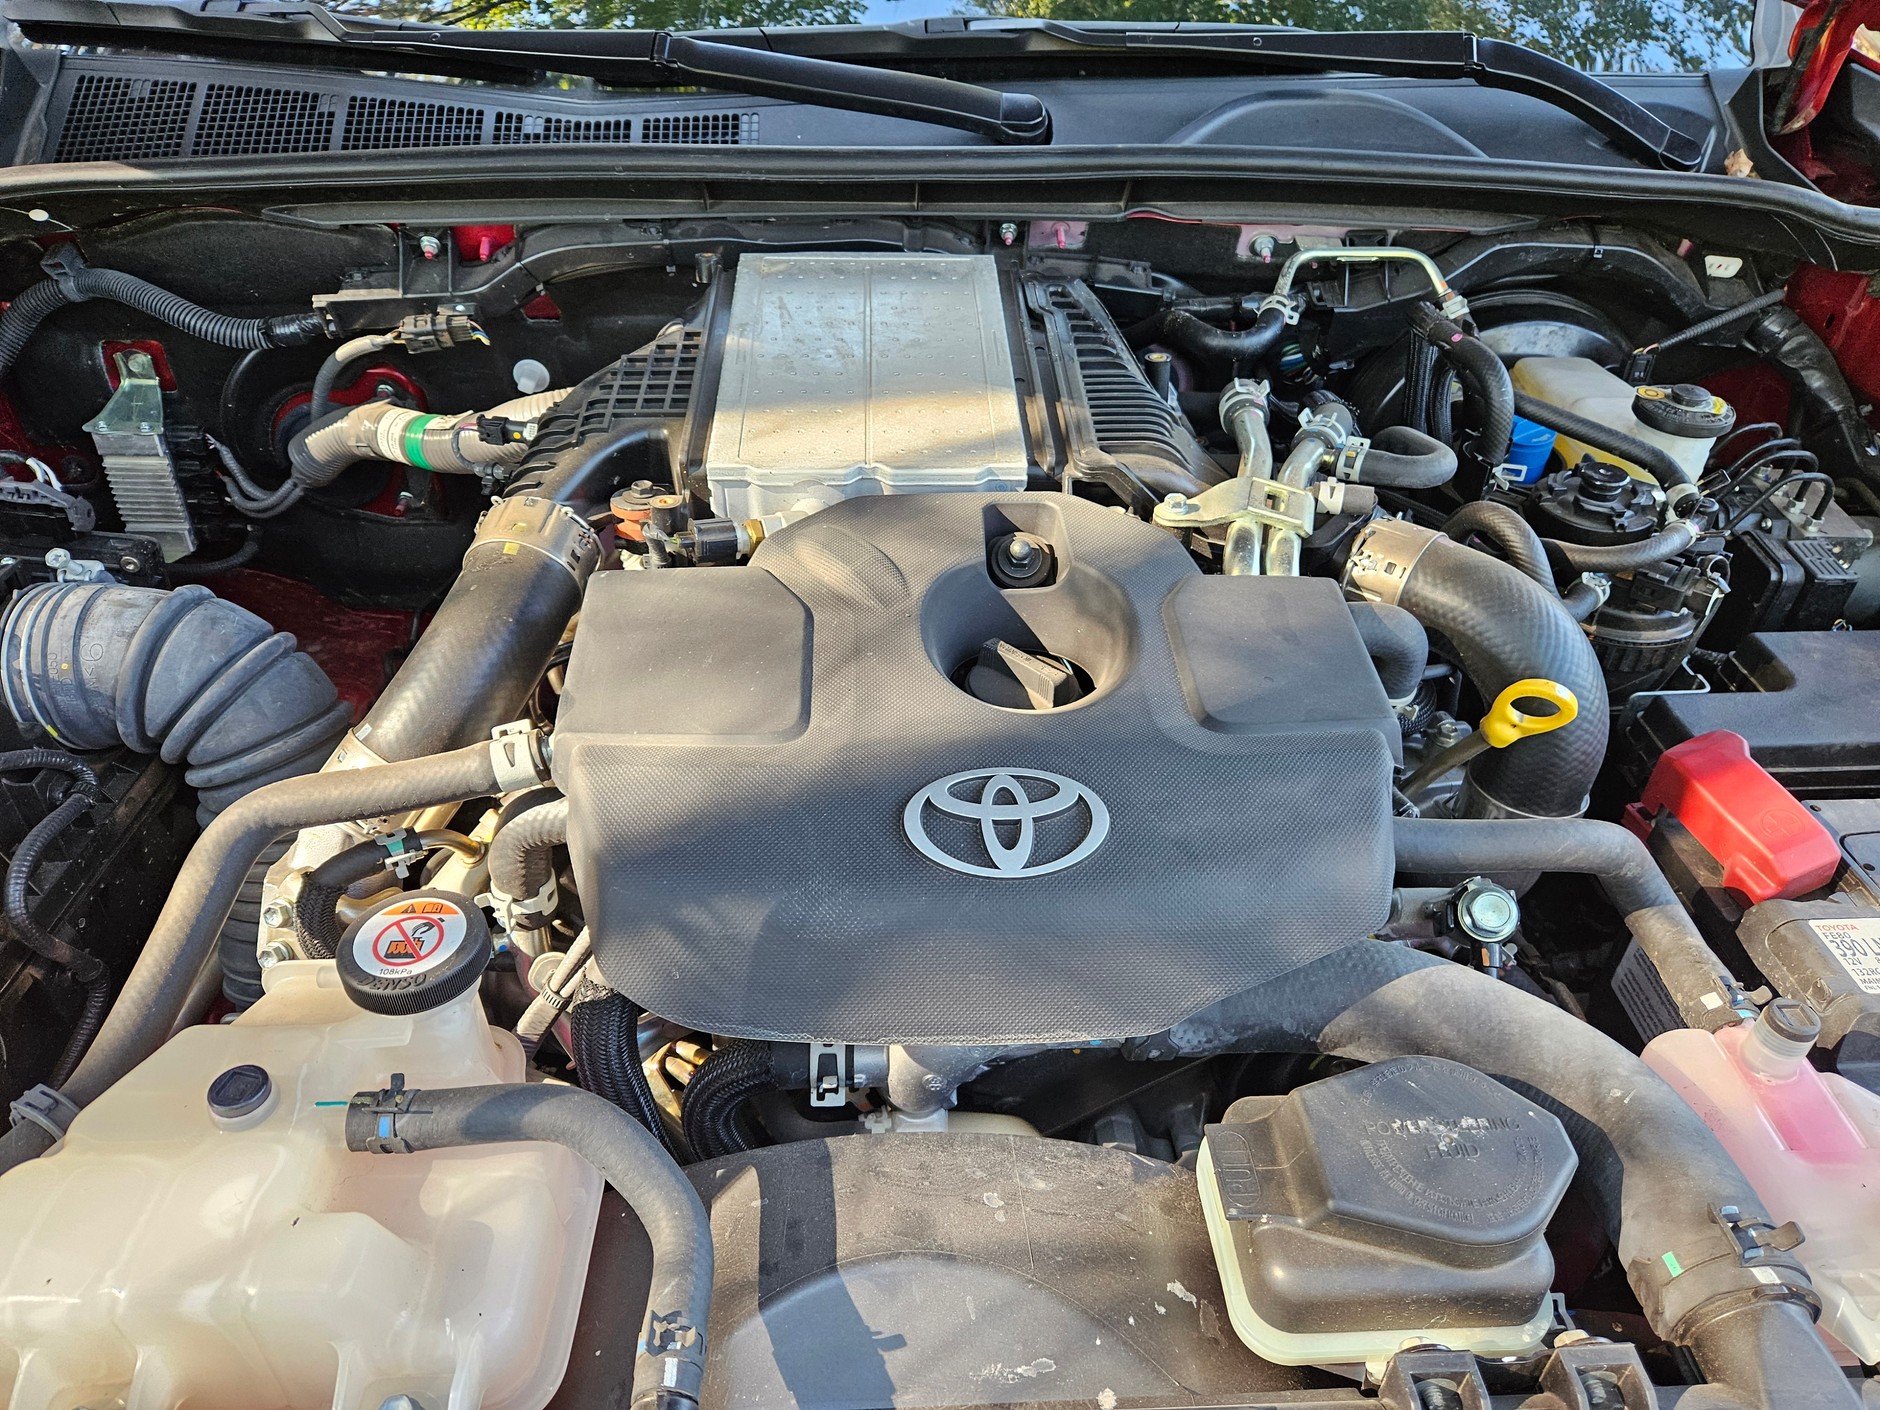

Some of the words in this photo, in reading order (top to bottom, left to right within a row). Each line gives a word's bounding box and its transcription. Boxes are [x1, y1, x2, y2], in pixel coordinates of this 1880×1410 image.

[1843, 957, 1862, 966] 12V
[379, 967, 413, 976] 108kPa
[356, 973, 427, 991] DENSO
[1424, 1143, 1480, 1159] FLUID
[1217, 1141, 1258, 1197] PULL
